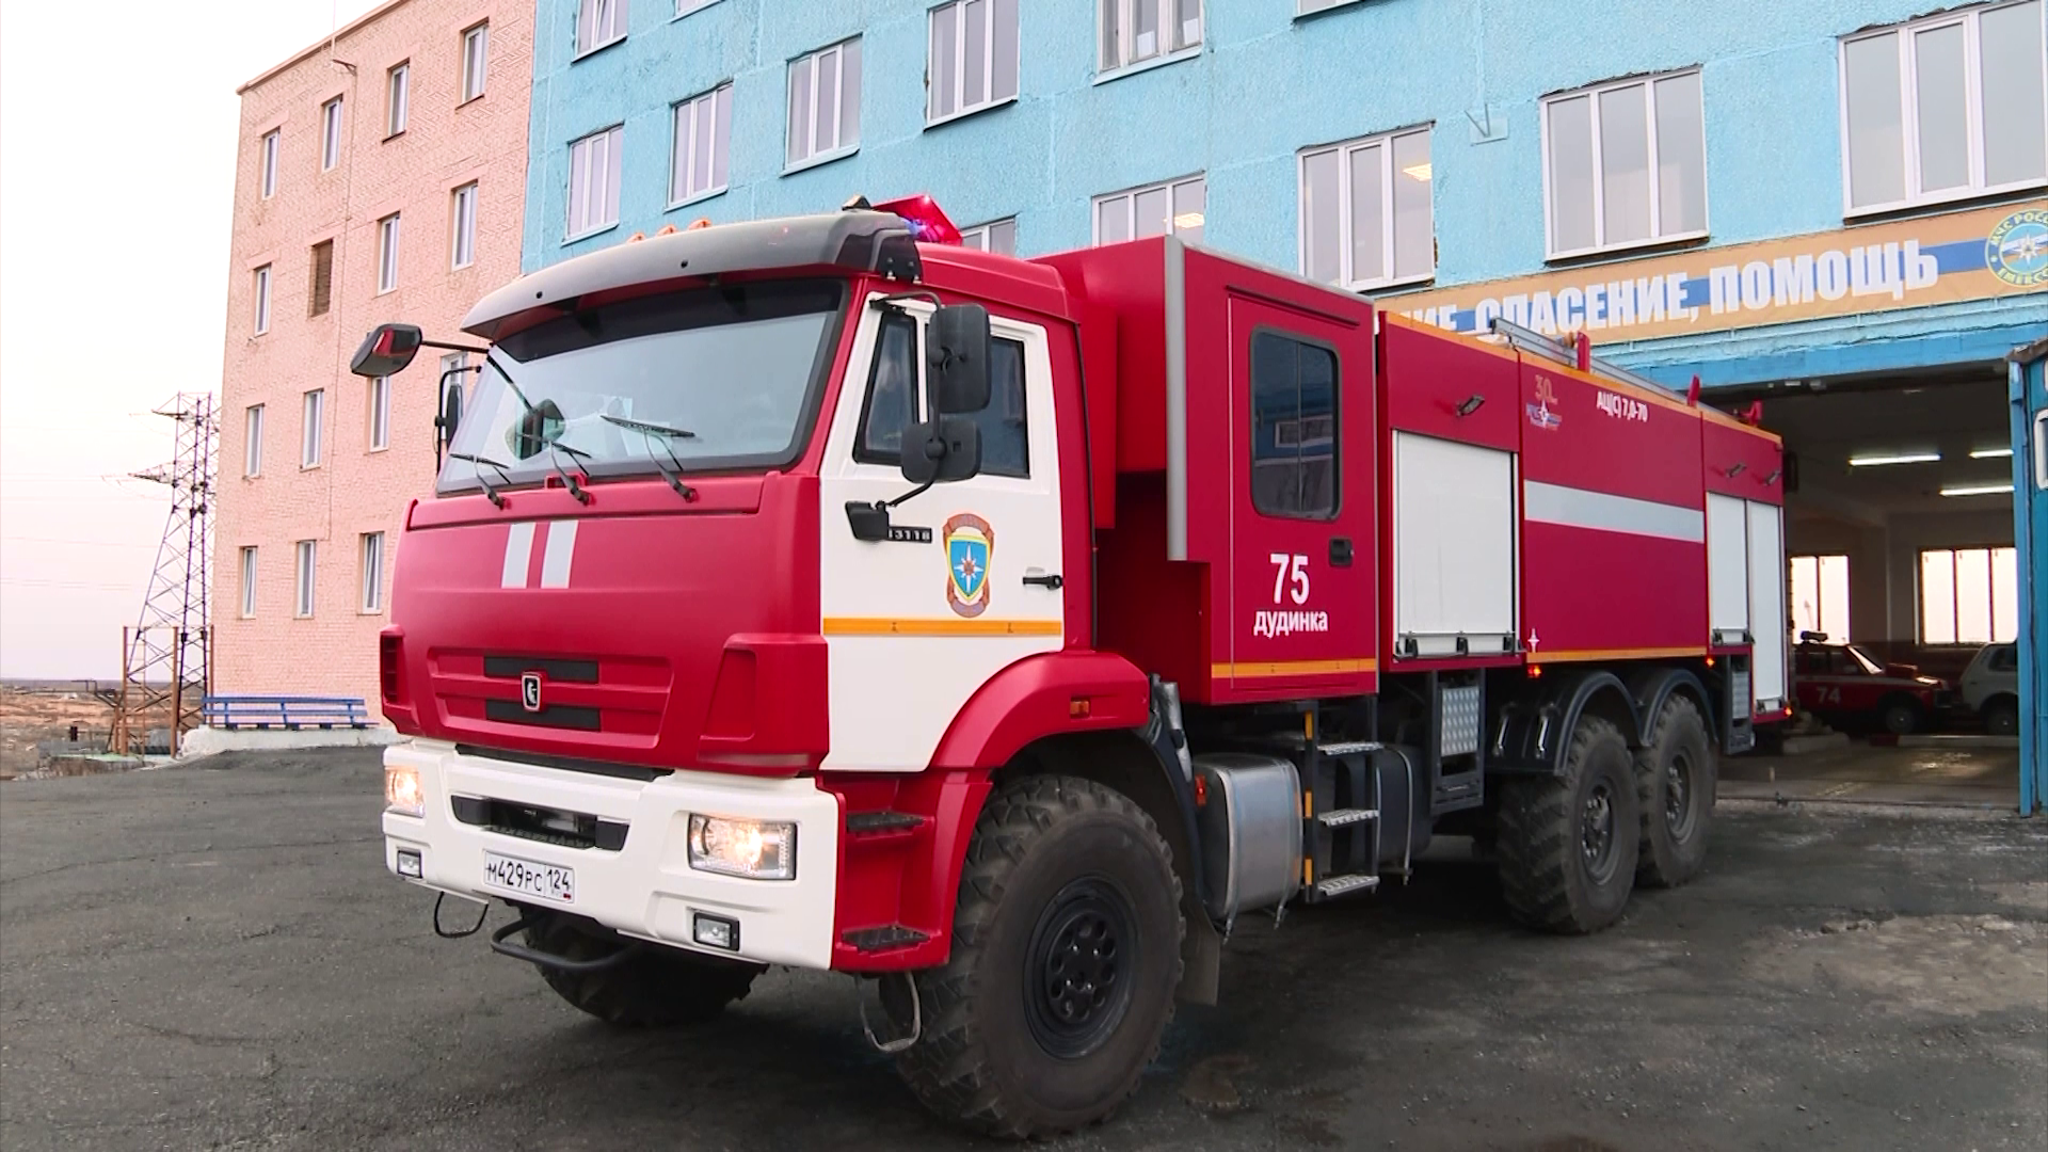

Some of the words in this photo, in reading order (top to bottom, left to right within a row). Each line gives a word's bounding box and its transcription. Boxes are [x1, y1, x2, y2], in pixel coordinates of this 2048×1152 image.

[1400, 304, 1457, 331] ИЕ
[1475, 272, 1699, 336] СПАСЕНИЕ,
[1709, 238, 1938, 314] ПОМОЩЬ
[1535, 374, 1552, 401] 30
[1270, 553, 1310, 605] 75
[1253, 610, 1329, 639] дудинка
[1816, 685, 1841, 705] 74
[546, 868, 571, 892] 124
